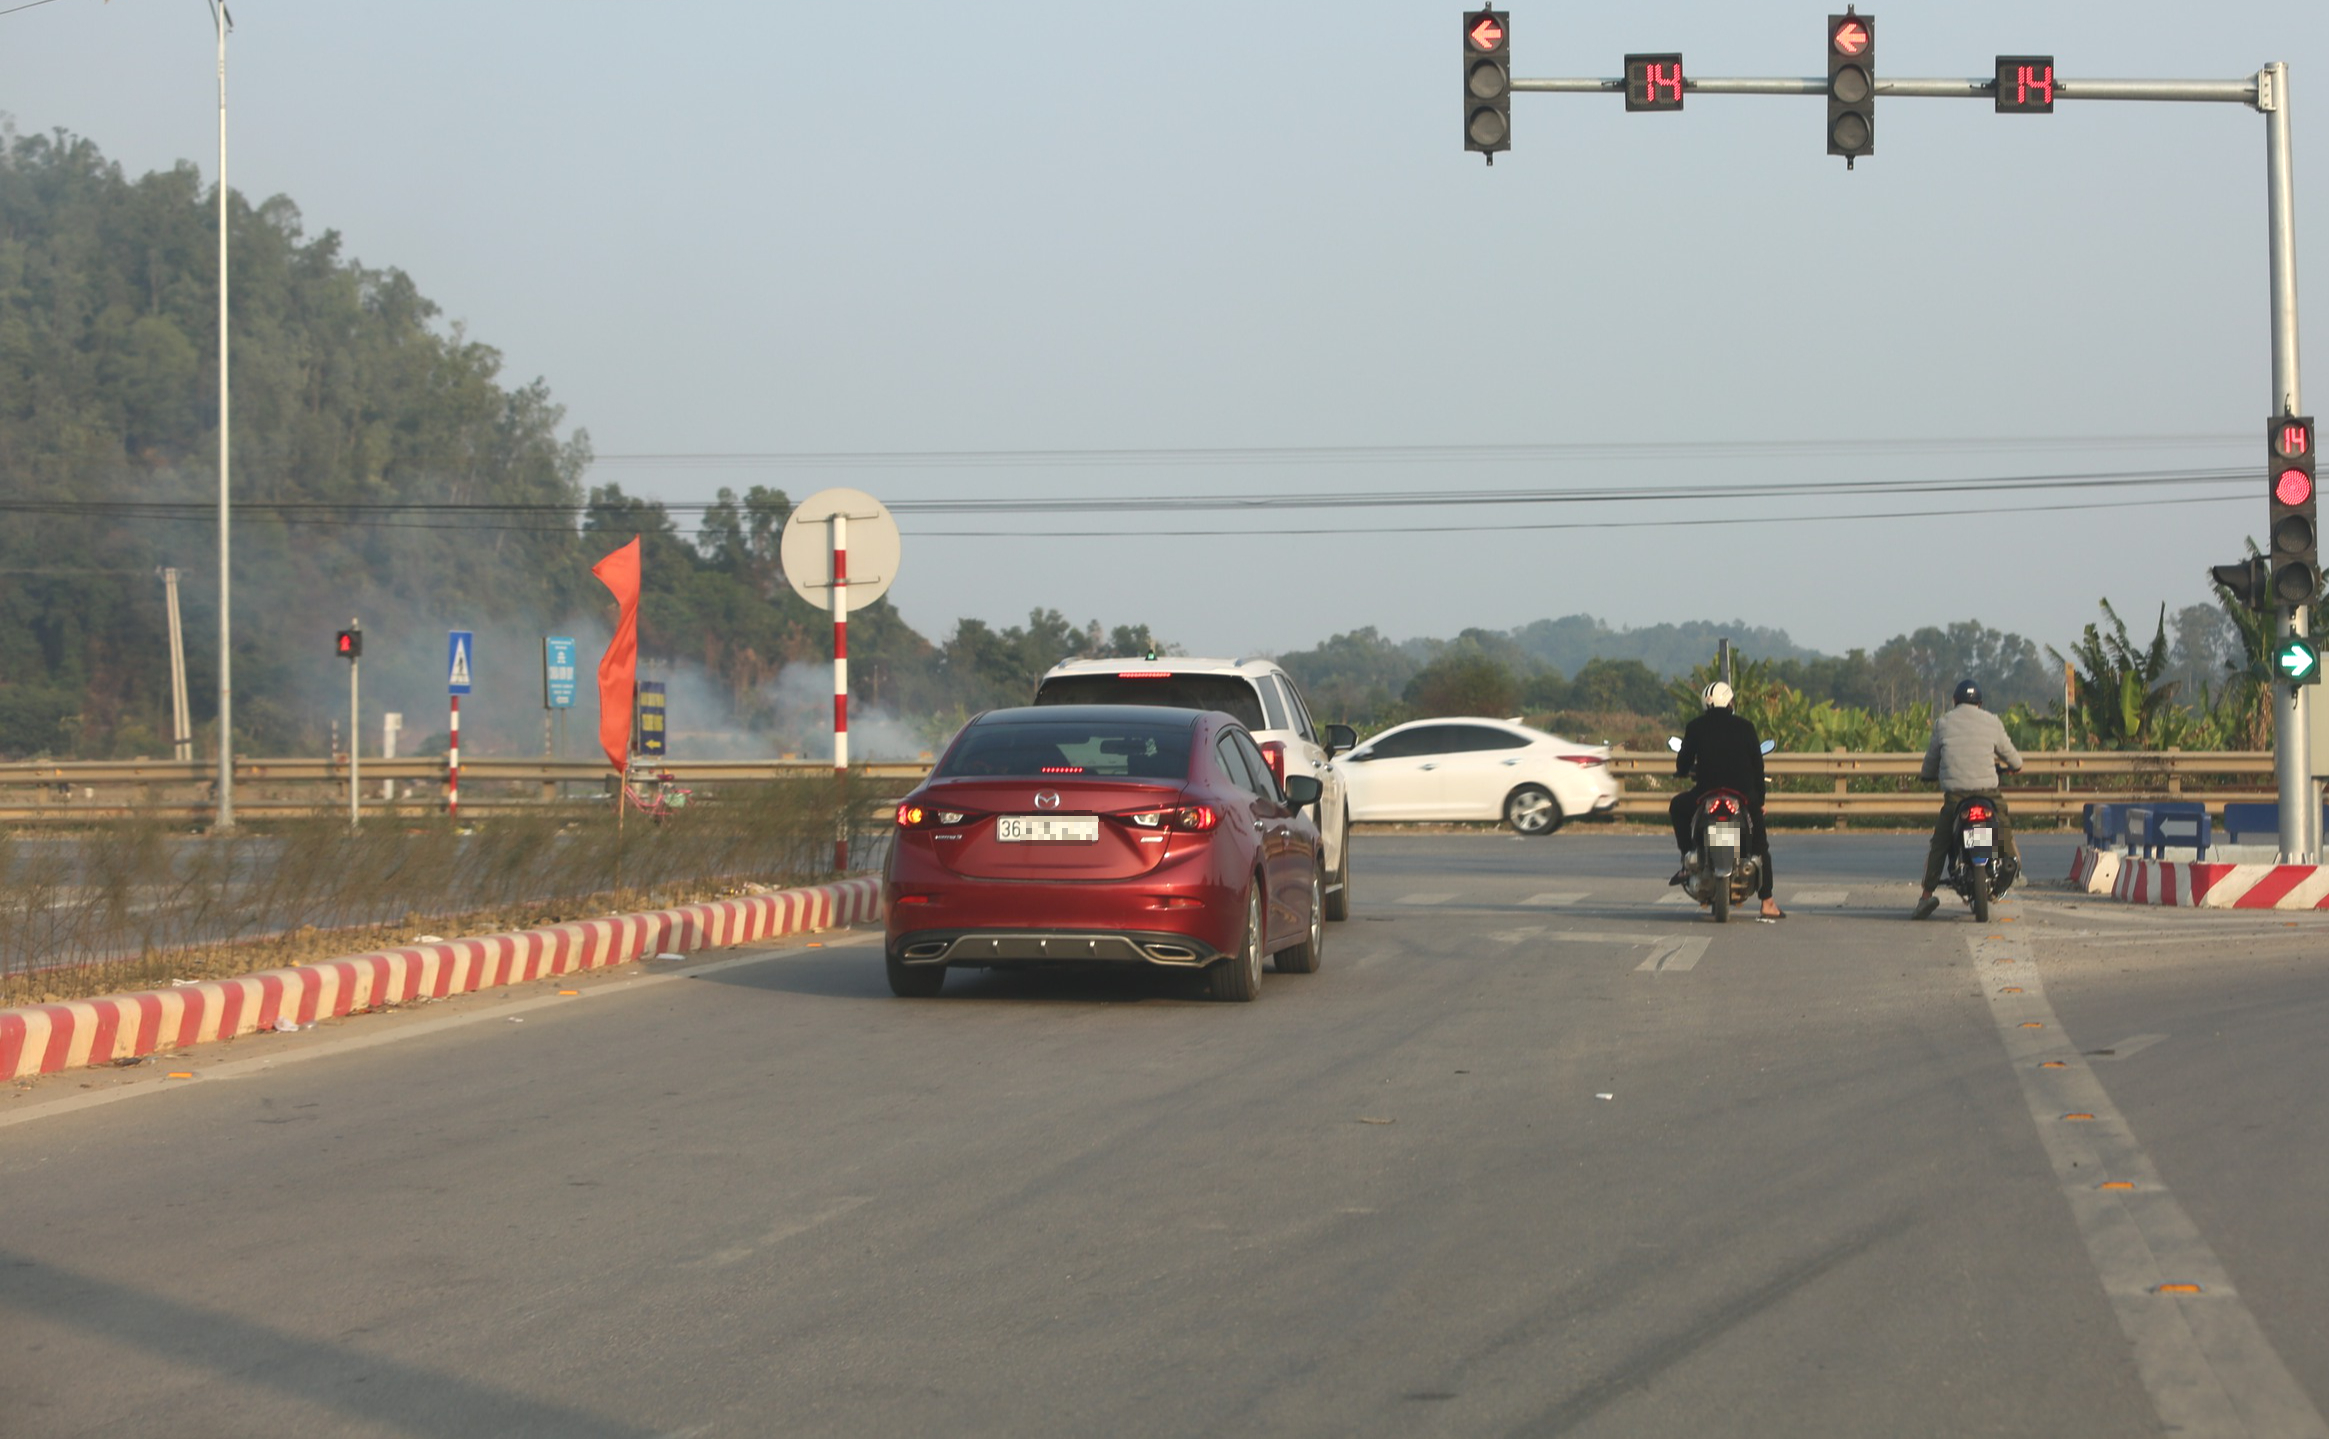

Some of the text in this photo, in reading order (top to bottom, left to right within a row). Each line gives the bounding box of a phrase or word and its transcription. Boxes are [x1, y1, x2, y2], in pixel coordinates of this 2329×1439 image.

[1646, 63, 1681, 102] 14
[2018, 65, 2052, 104] 14
[2284, 427, 2306, 454] 14
